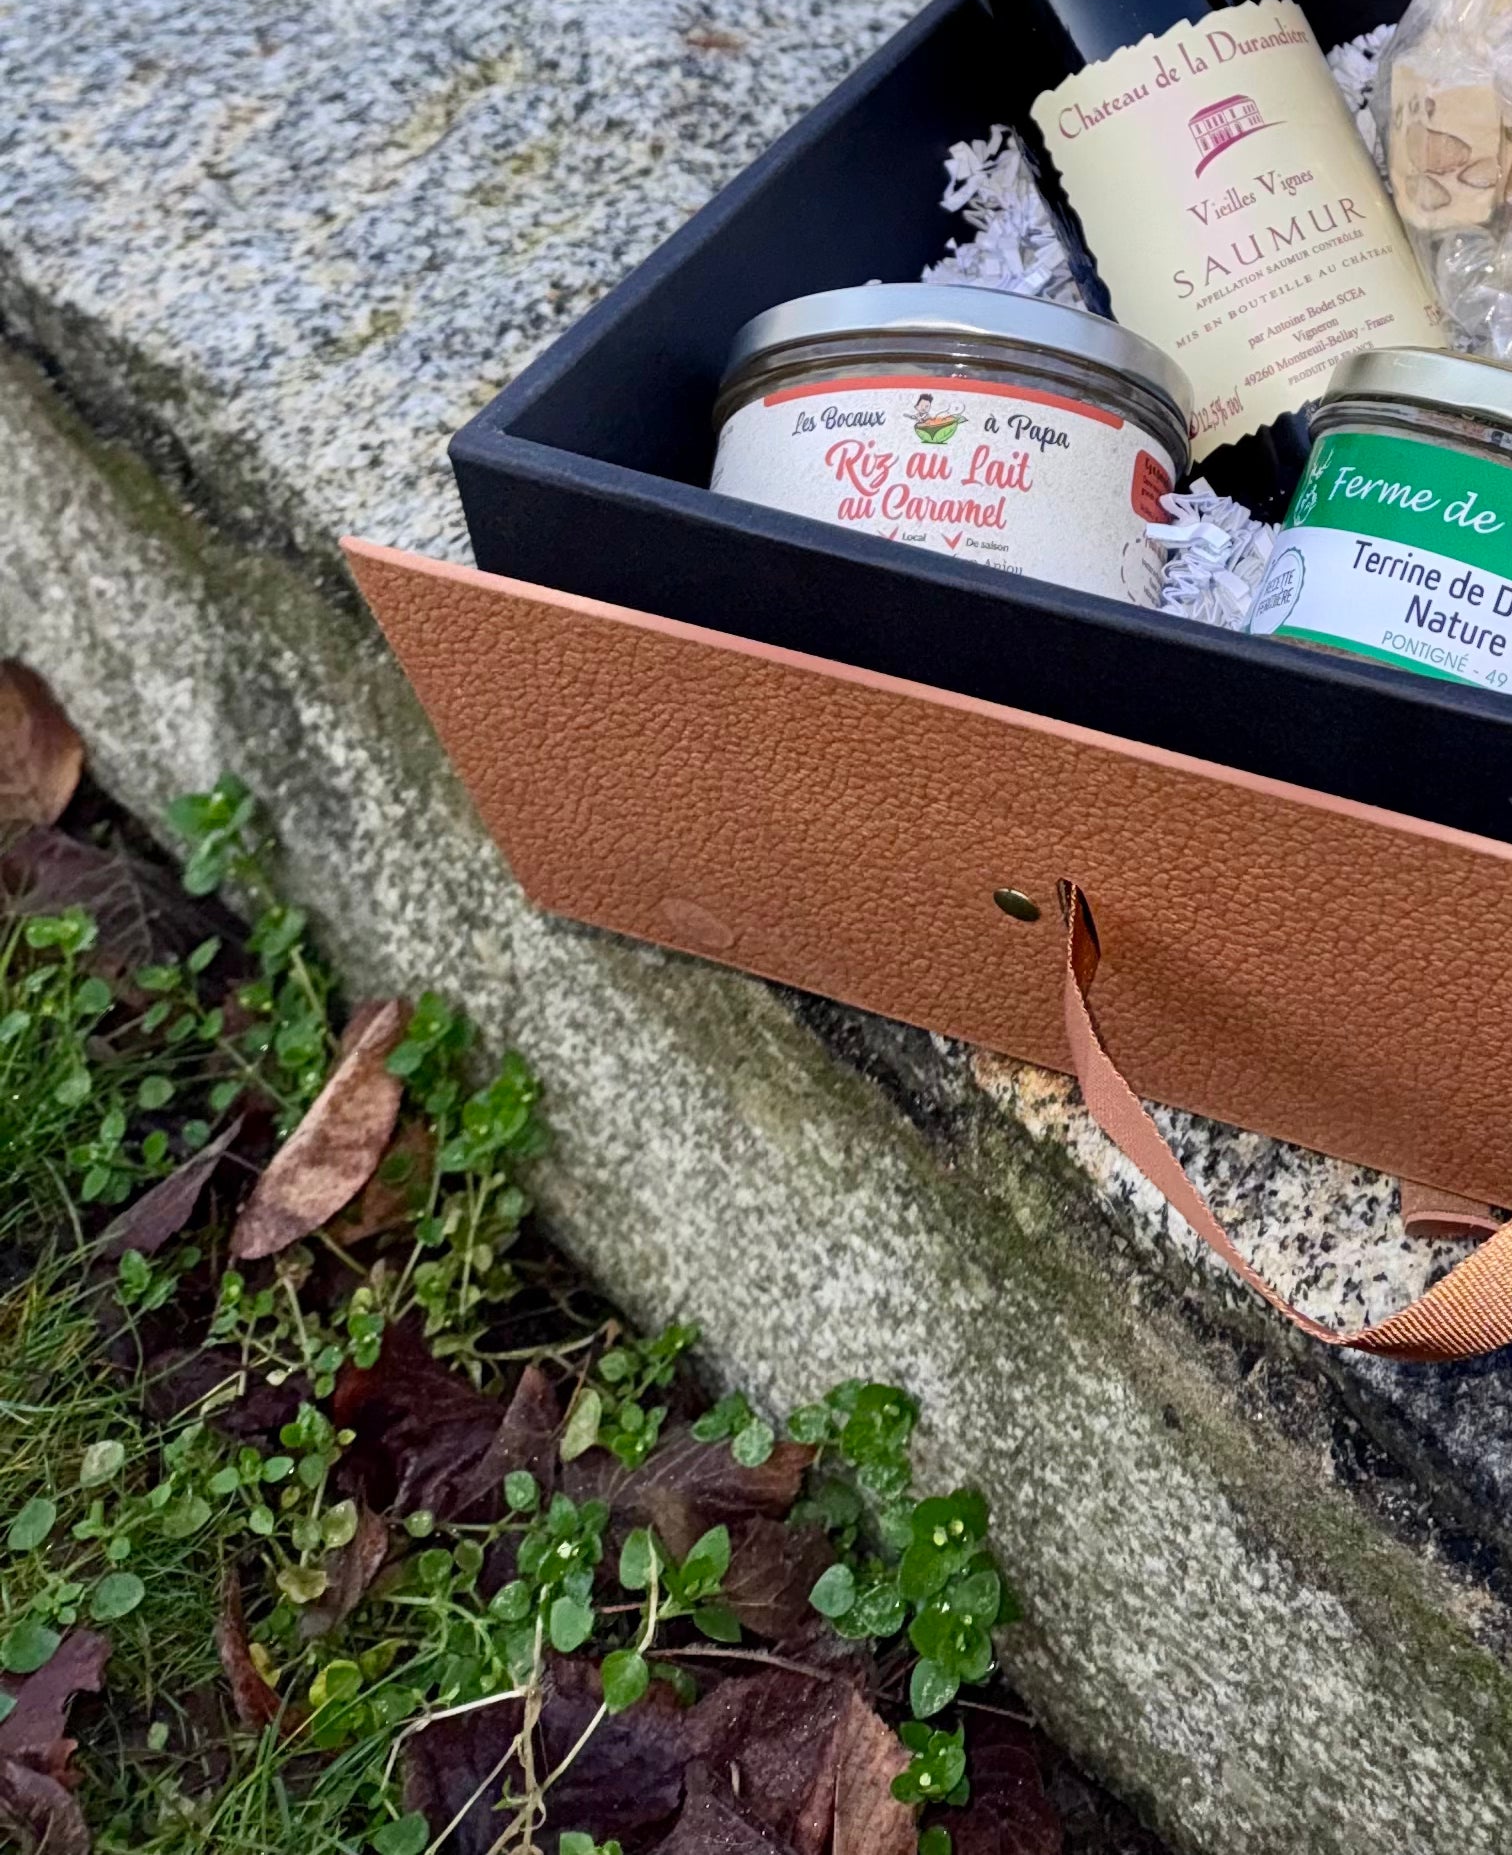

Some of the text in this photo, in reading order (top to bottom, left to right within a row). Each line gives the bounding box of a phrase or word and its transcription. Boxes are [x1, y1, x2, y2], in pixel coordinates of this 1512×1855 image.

[1153, 55, 1181, 89] de
[1178, 43, 1208, 75] la
[1187, 169, 1315, 225] Vieilles Vignes
[1173, 197, 1367, 299] SAUMUR
[1176, 330, 1199, 349] MIS
[1203, 317, 1223, 333] EN
[1228, 274, 1312, 320] BOUTEILLE
[1318, 264, 1337, 279] AU
[1196, 270, 1264, 310] APPELLATION
[1266, 249, 1310, 274] SAUMUR
[1248, 286, 1367, 349] par Antoine Bodet SCEA
[1292, 317, 1340, 343] Vigneron
[1244, 366, 1276, 388] 49260
[1275, 327, 1360, 371] Montreuil-Bellay
[1365, 312, 1396, 331] France
[791, 405, 886, 436] Les Bocaux
[984, 413, 1070, 452] à Papa
[825, 439, 1033, 497] Riz au Lait
[838, 483, 1008, 530] au Caramel
[1328, 466, 1440, 512] Ferme
[1443, 491, 1505, 534] de
[902, 532, 927, 542] Local
[966, 538, 1010, 552] De saison
[1352, 539, 1441, 591] Terrine
[1449, 570, 1485, 606] de
[1404, 594, 1507, 657] Nature
[1381, 630, 1470, 673] PONTIGNÉ
[1484, 669, 1509, 688] 49
